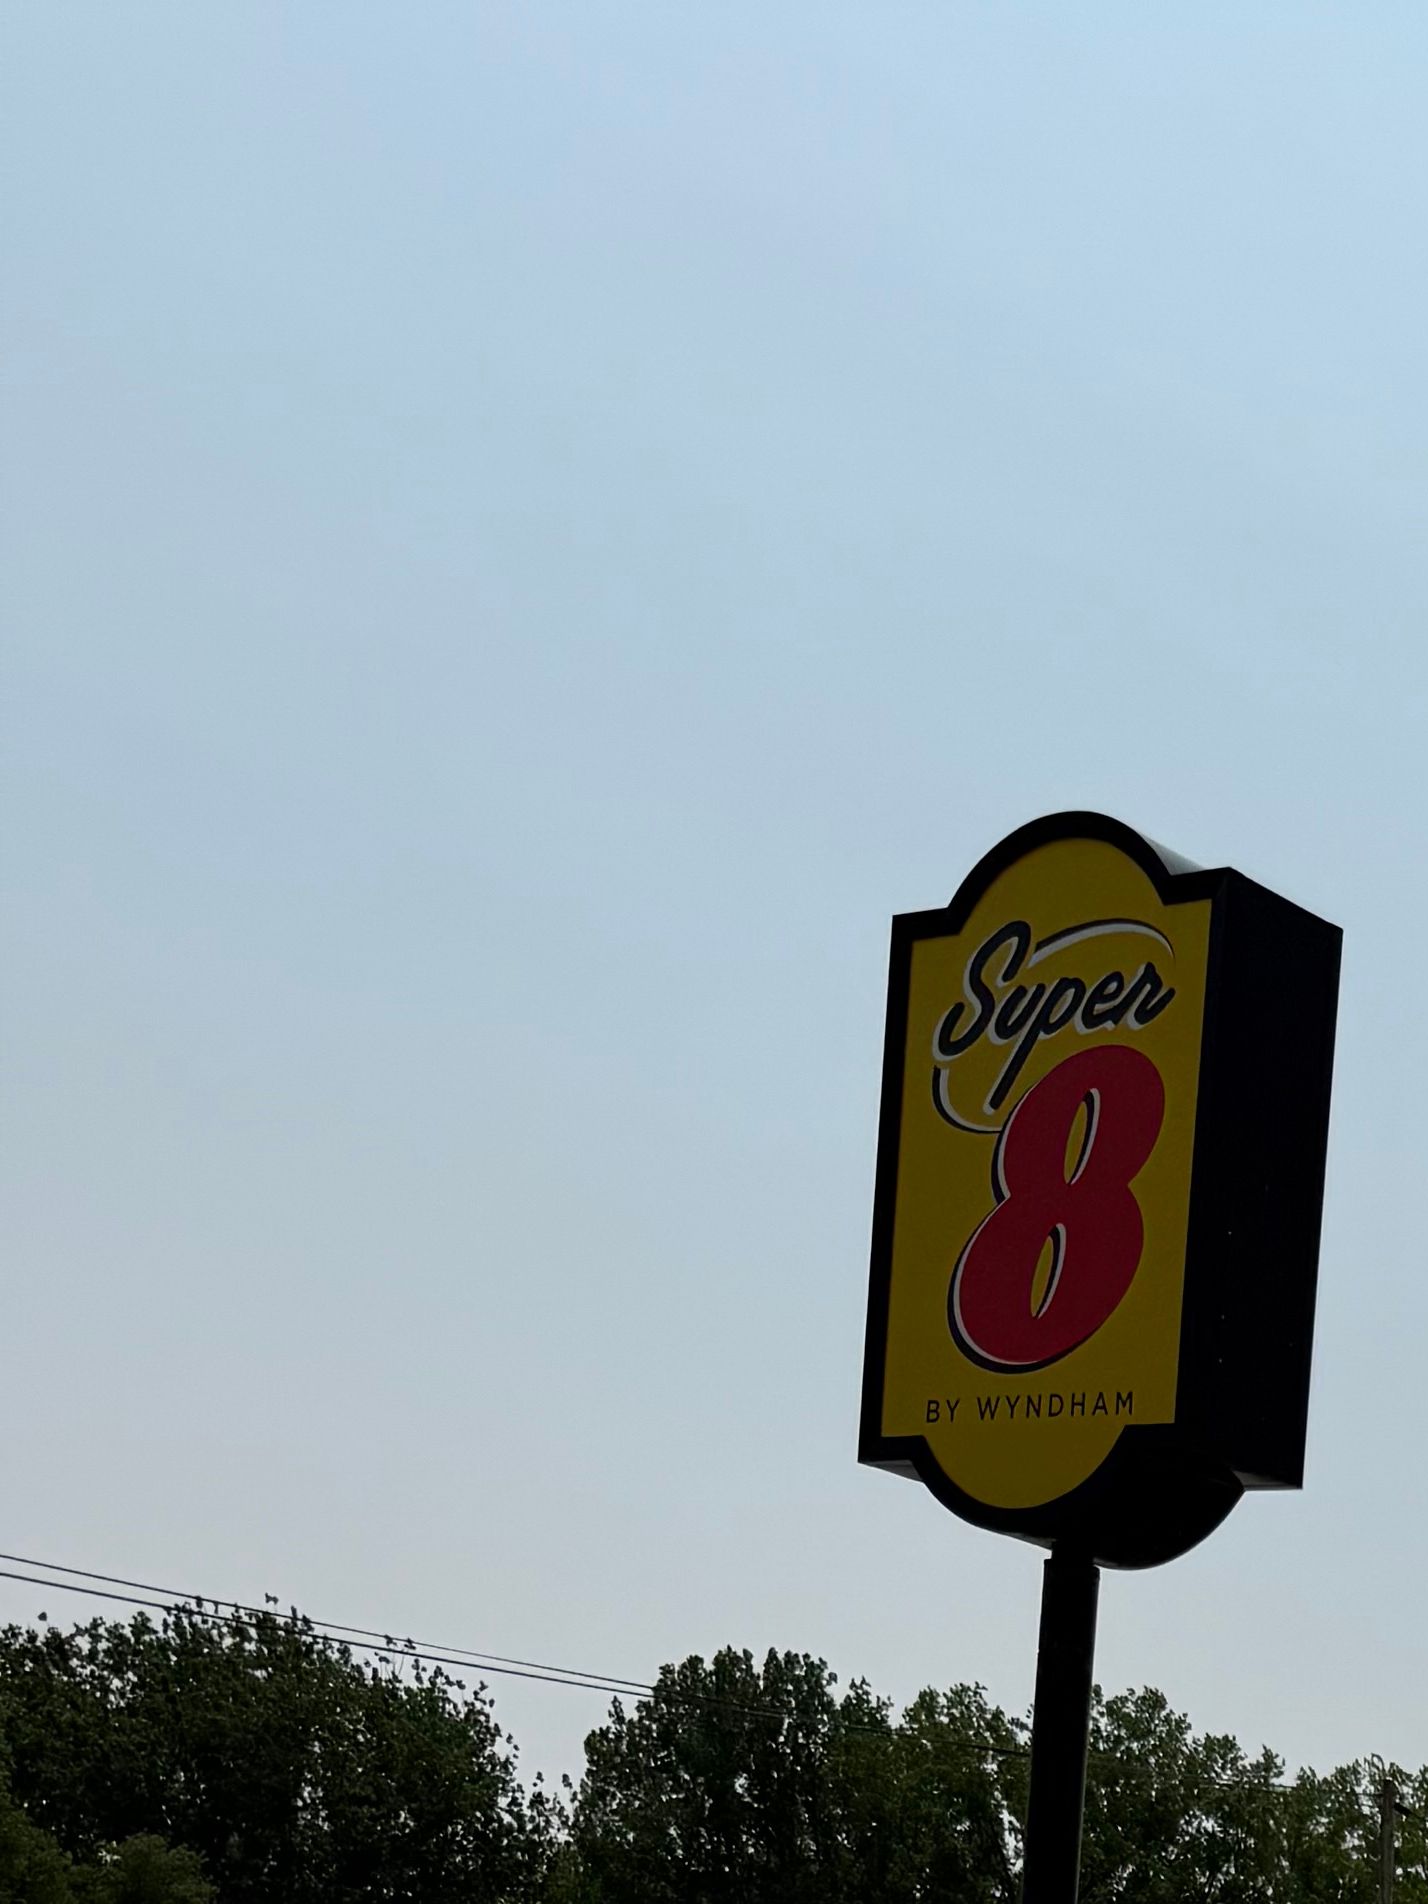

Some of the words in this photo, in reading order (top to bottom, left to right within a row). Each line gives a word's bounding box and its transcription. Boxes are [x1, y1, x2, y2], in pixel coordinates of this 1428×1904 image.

[933, 919, 1176, 1116] Super
[947, 1044, 1165, 1374] 8
[926, 1398, 960, 1423] BY
[977, 1391, 1133, 1420] WYNDHAM
